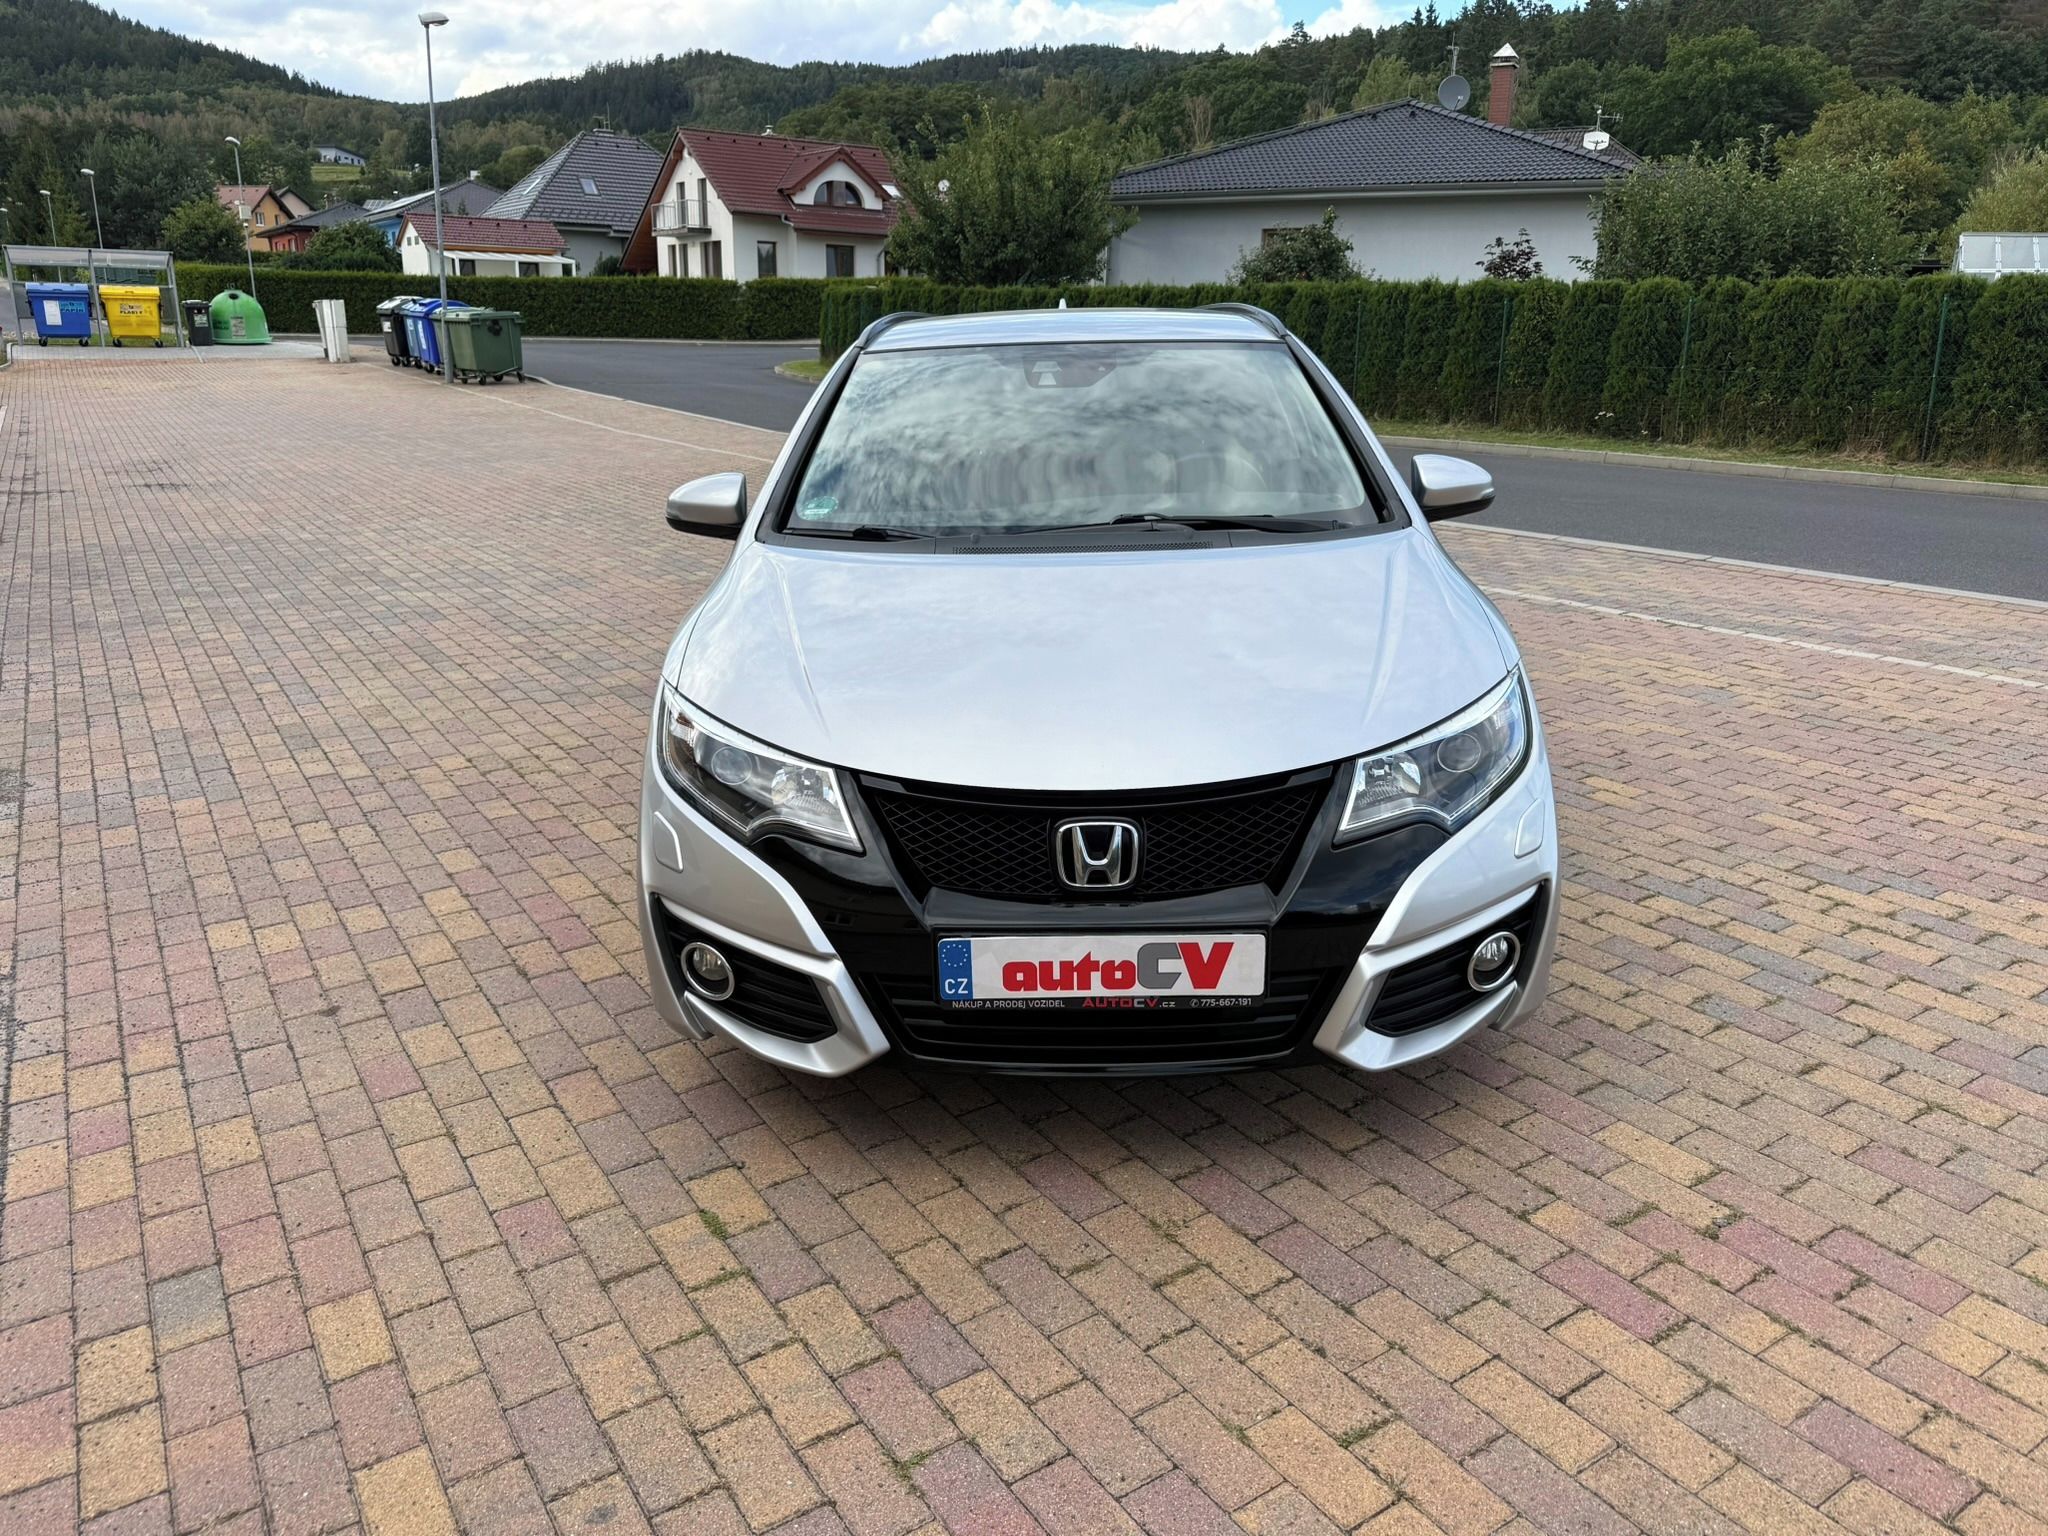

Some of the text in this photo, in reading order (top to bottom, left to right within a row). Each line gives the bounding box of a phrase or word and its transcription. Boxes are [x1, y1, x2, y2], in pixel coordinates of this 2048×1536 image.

[1002, 942, 1235, 992] autoCV
[945, 978, 969, 994] CZ
[984, 1000, 992, 1008] A
[993, 1000, 1026, 1009] PRODEJ
[1028, 999, 1065, 1008] VOZIDEL
[1200, 998, 1252, 1007] 775-667-191
